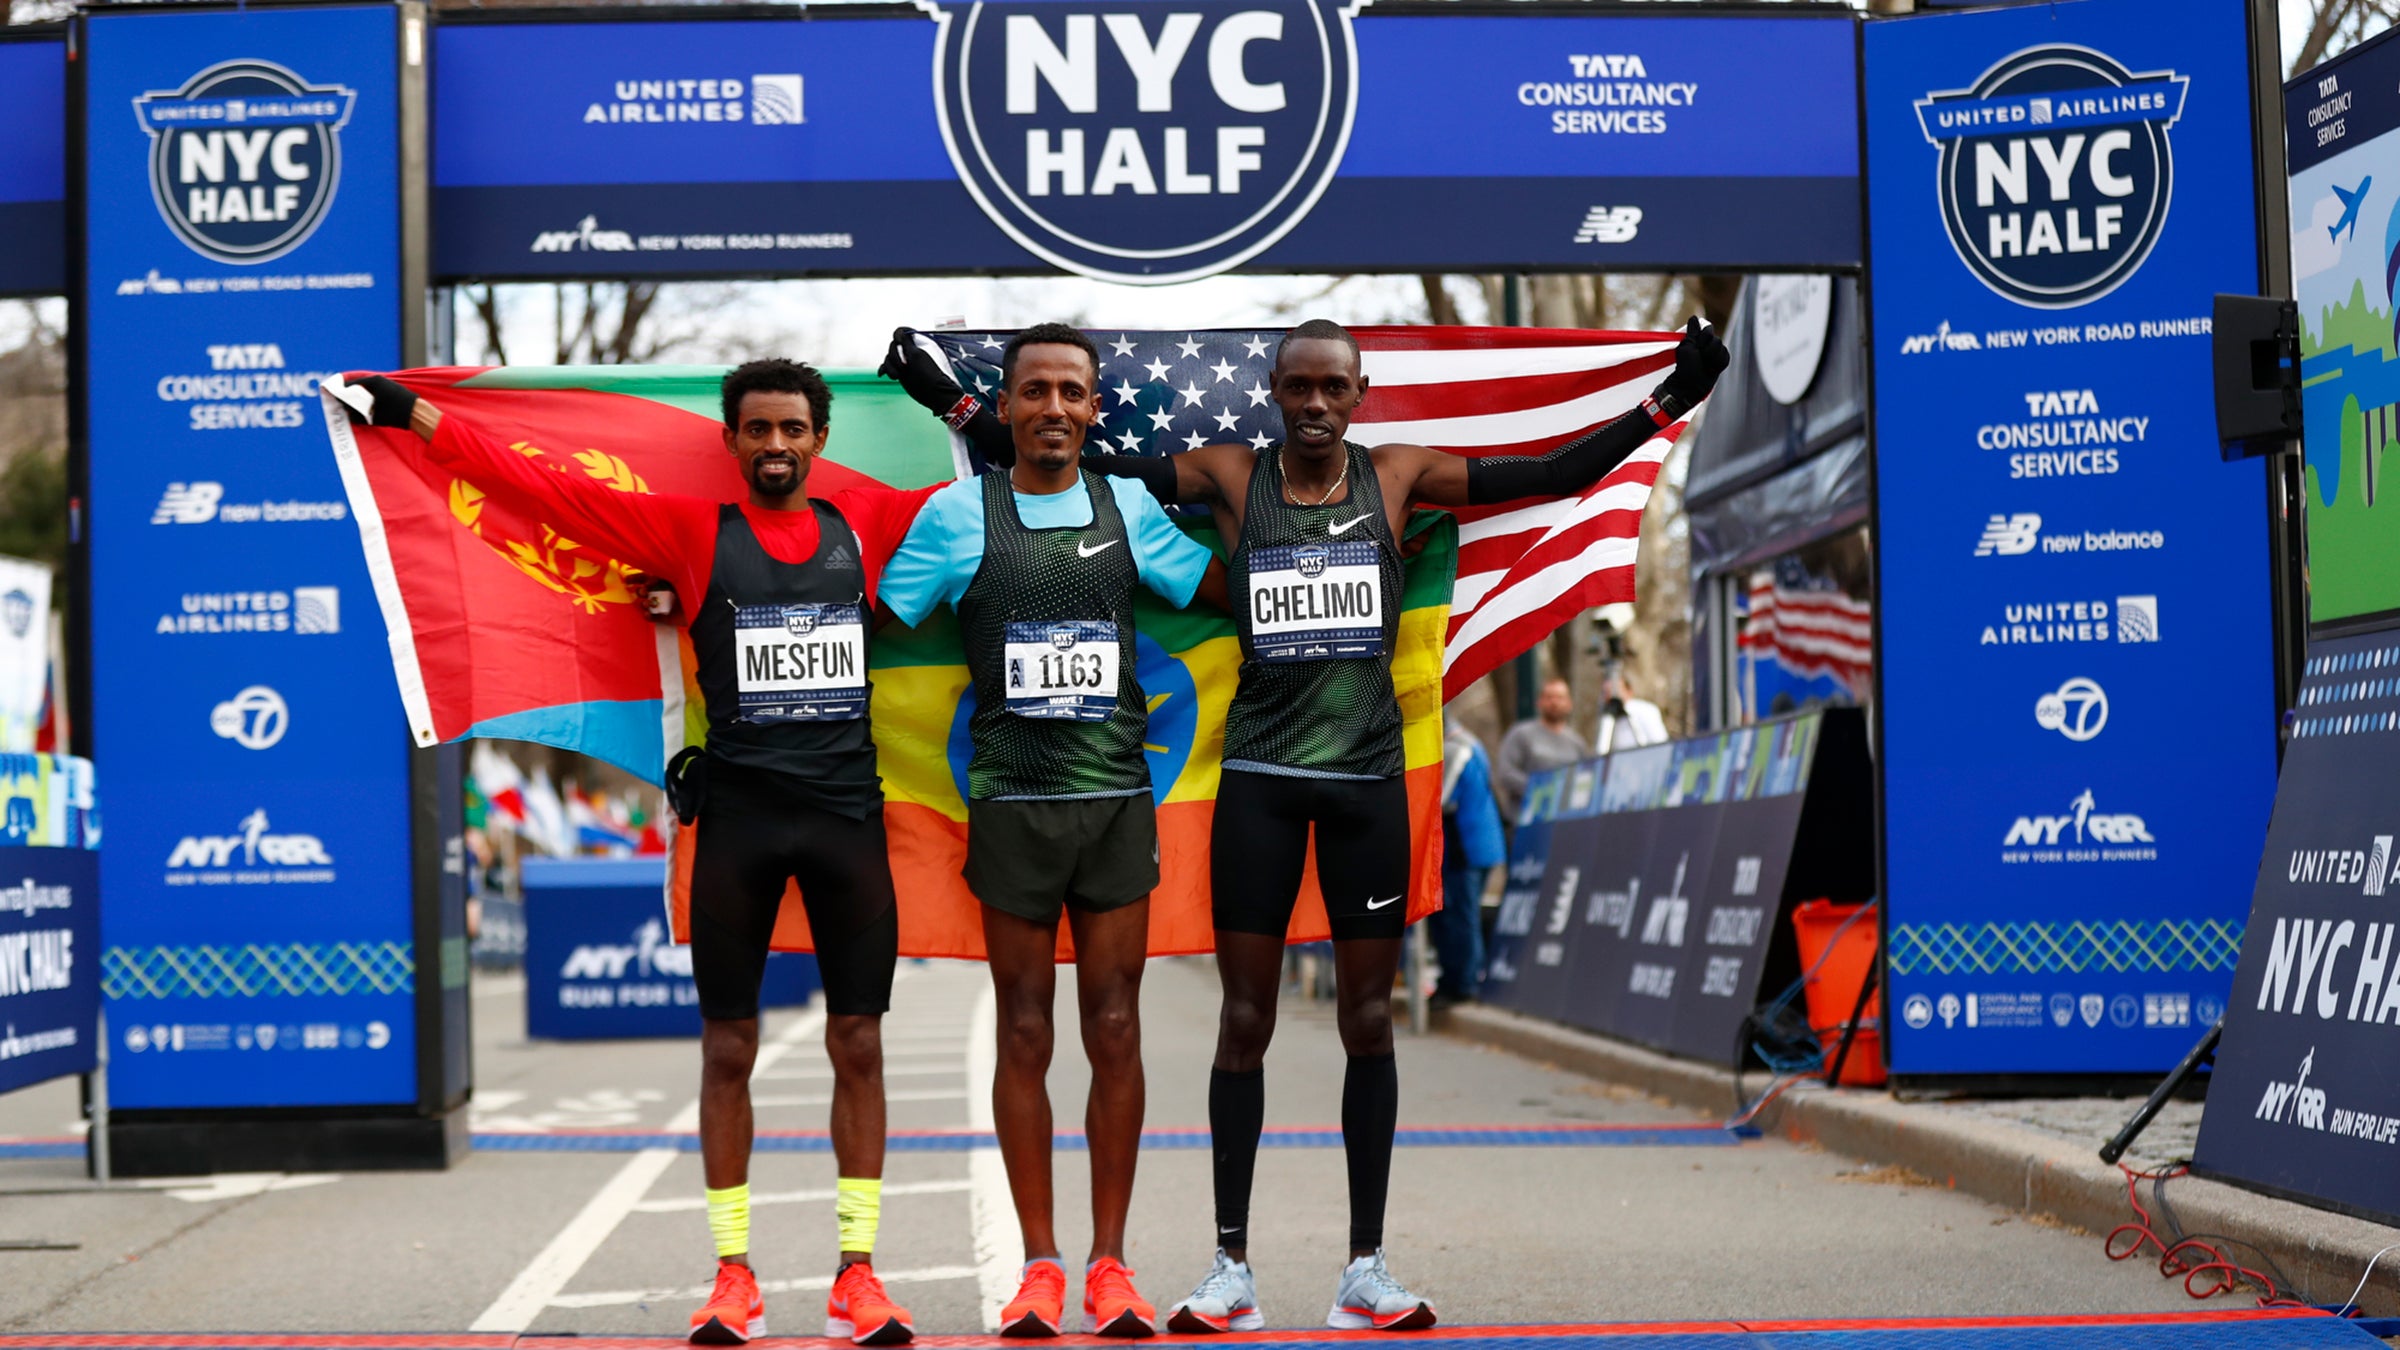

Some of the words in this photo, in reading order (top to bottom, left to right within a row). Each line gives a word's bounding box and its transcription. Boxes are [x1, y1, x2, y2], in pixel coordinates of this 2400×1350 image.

[1005, 10, 1287, 114] NYC
[1568, 55, 1647, 78] TATA
[615, 79, 744, 101] UNITED
[1517, 82, 1698, 106] CONSULTANCY
[2318, 74, 2338, 98] TATA
[151, 105, 225, 121] UNITED
[248, 101, 338, 117] AIRLINES
[583, 101, 744, 123] AIRLINES
[1551, 110, 1667, 134] SERVICES
[1938, 106, 2026, 128] UNITED
[2057, 92, 2166, 118] AIRLINES
[2308, 91, 2352, 128] CONSULTANCY
[2317, 118, 2346, 148] SERVICES
[179, 128, 310, 184] NYC
[1026, 126, 1266, 196] HALF
[1975, 129, 2135, 208] NYC
[188, 185, 300, 224] HALF
[638, 235, 679, 251] NEW
[681, 234, 727, 252] YORK
[728, 233, 776, 251] ROAD
[776, 231, 854, 250] RUNNERS
[1988, 204, 2124, 259] HALF
[184, 279, 220, 293] NEW
[222, 278, 261, 292] YORK
[261, 276, 305, 291] ROAD
[305, 273, 375, 290] RUNNERS
[1986, 331, 2029, 348] NEW
[2032, 327, 2081, 345] YORK
[2085, 323, 2136, 342] ROAD
[2140, 317, 2213, 338] RUNNER
[207, 344, 284, 370] TATA
[190, 402, 304, 430] SERVICES
[2025, 389, 2100, 417] TATA
[1977, 416, 2149, 451] CONSULTANCY
[2009, 448, 2120, 479] SERVICES
[219, 504, 262, 523] new
[262, 500, 347, 521] balance
[2042, 534, 2081, 553] new
[2084, 529, 2164, 551] balance
[1300, 556, 1323, 567] NYC
[181, 593, 290, 613] UNITED
[1254, 581, 1374, 625] CHELIMO
[2005, 602, 2109, 623] UNITED
[155, 613, 290, 634] AIRLINES
[789, 615, 813, 626] NYC
[1980, 622, 2110, 645] AIRLINES
[1053, 632, 1075, 642] NYC
[745, 641, 854, 682] MESFUN
[1039, 653, 1103, 689] 1163
[1048, 696, 1077, 705] WAVE
[2038, 703, 2064, 718] abc
[2002, 800, 2156, 847] NYRR
[166, 820, 334, 868] NYRR
[2002, 850, 2031, 864] NEW
[2032, 849, 2065, 863] YORK
[2066, 848, 2099, 862] ROAD
[2102, 846, 2158, 862] RUNNERS
[2289, 850, 2364, 883] UNITED
[560, 932, 694, 979] NYR
[2257, 917, 2356, 1020] NYC
[2347, 922, 2400, 1026] HA
[560, 985, 614, 1008] RUN
[617, 984, 670, 1007] FOR
[2255, 1061, 2326, 1131] NYRR
[2330, 1108, 2355, 1136] RUN
[2352, 1112, 2376, 1140] FOR
[2374, 1116, 2400, 1145] LIFE
